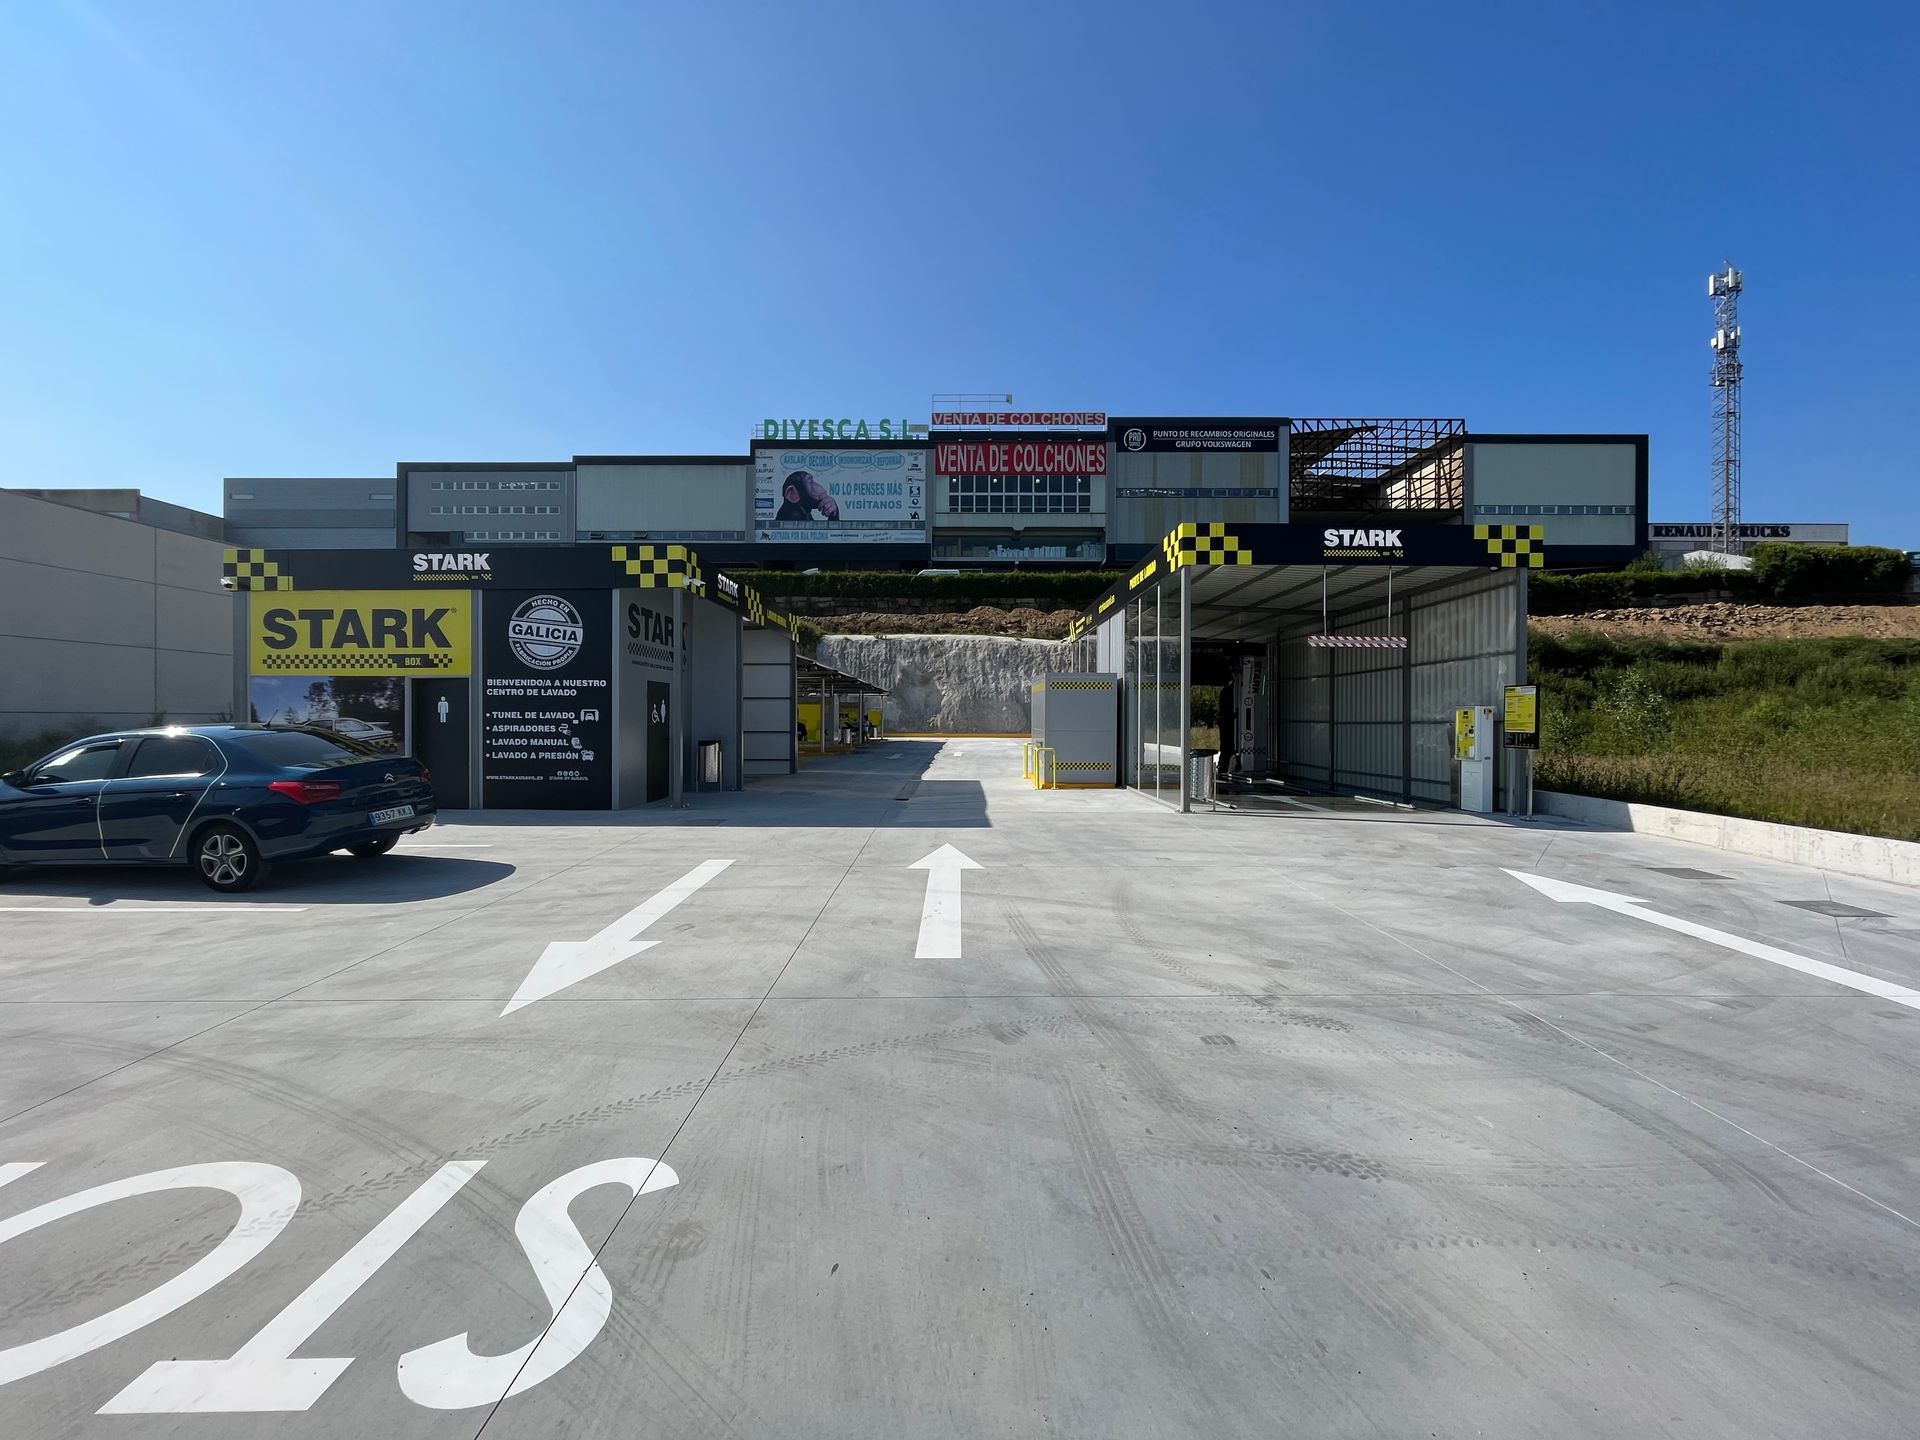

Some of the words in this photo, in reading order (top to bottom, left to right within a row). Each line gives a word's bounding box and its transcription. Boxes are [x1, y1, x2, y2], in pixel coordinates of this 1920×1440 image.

[934, 413, 982, 425] VENTA
[985, 413, 1005, 425] DE
[1008, 413, 1104, 426] COLCHONES
[763, 419, 870, 440] DIYESCA
[1153, 430, 1178, 438] PUNTO
[1179, 430, 1189, 438] DE
[1190, 430, 1231, 438] RECAMBIOS
[1233, 430, 1275, 438] ORIGINALES
[1176, 440, 1201, 448] GRUPO
[1202, 440, 1251, 448] VOLKSWAGEN
[938, 444, 986, 472] VENTA
[989, 444, 1009, 472] DE
[1013, 444, 1106, 473] COLCHONES
[830, 483, 841, 496] NO
[842, 483, 852, 496] LO
[854, 483, 885, 496] PIENSES
[886, 480, 903, 496] MÁS
[1323, 528, 1403, 547] STARK
[412, 553, 491, 572] STARK
[717, 573, 739, 598] STARK
[531, 598, 559, 608] HECHO
[559, 602, 570, 613] EN
[262, 608, 453, 649] STARK
[511, 623, 579, 642] GALICIA
[404, 657, 421, 666] BOX
[514, 643, 552, 667] FABRICACIÓN
[552, 648, 574, 666] PROPIA
[486, 678, 552, 688] BIENVENIDO/A
[553, 679, 561, 688] A
[562, 679, 607, 688] NUESTRO
[486, 688, 525, 697] CENTRO
[526, 688, 539, 697] DE
[541, 688, 577, 697] LAVADO
[492, 711, 523, 719] TUNEL
[524, 711, 537, 719] DE
[539, 711, 576, 719] LAVADO
[492, 725, 556, 733] ASPIRADORES
[492, 738, 528, 746] LAVADO
[530, 738, 569, 746] MANUAL
[491, 752, 528, 760] LAVADO
[529, 752, 537, 760] A
[539, 750, 579, 760] PRESIÓN
[375, 810, 395, 822] 9357
[0, 1157, 680, 1413] STO
